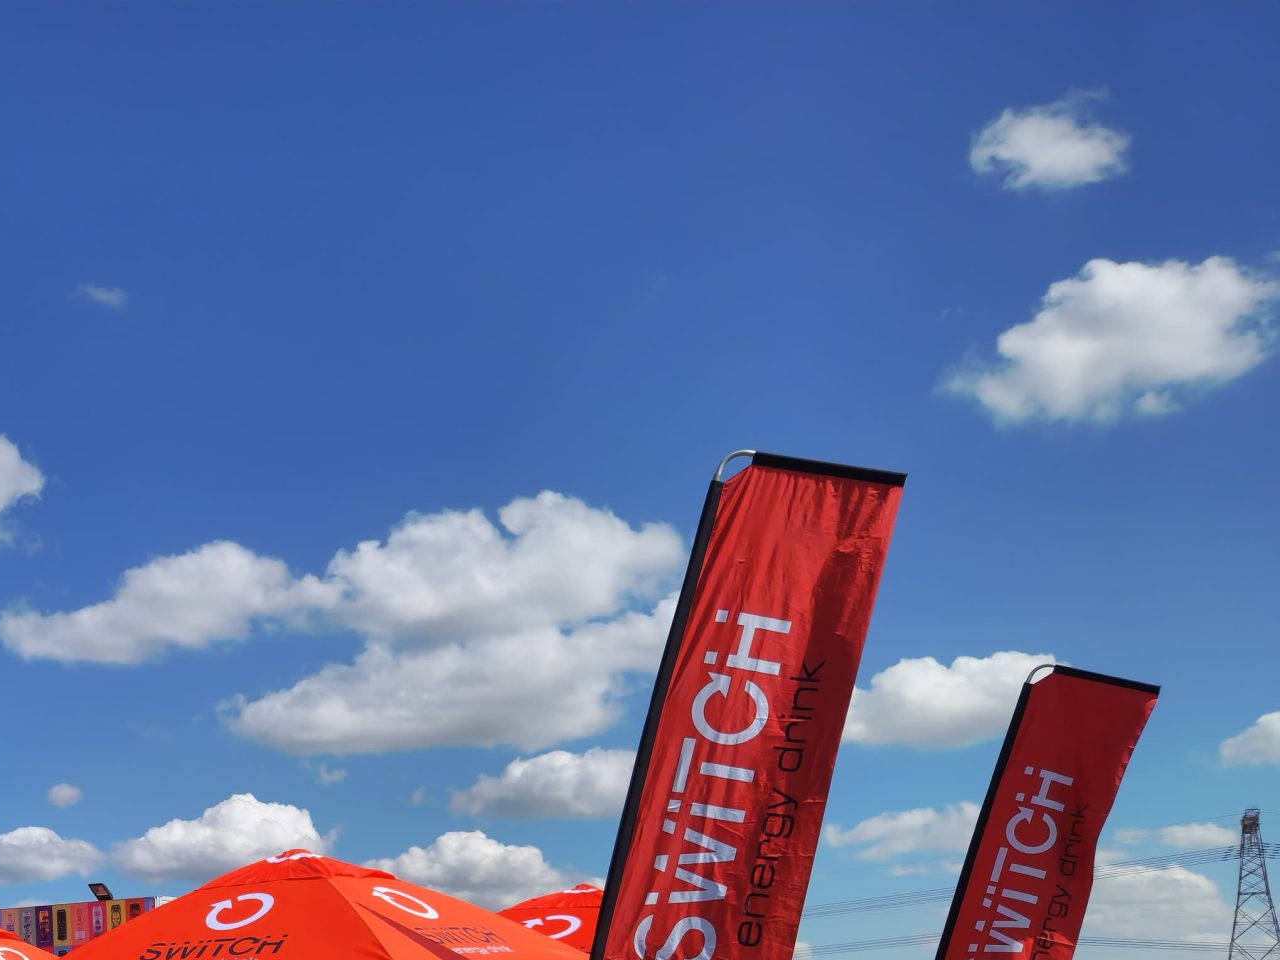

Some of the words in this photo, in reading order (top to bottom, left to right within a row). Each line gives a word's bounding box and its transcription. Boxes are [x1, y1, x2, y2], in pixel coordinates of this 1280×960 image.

[737, 787, 798, 948] energy
[773, 660, 825, 772] drink
[1060, 804, 1088, 877] drink
